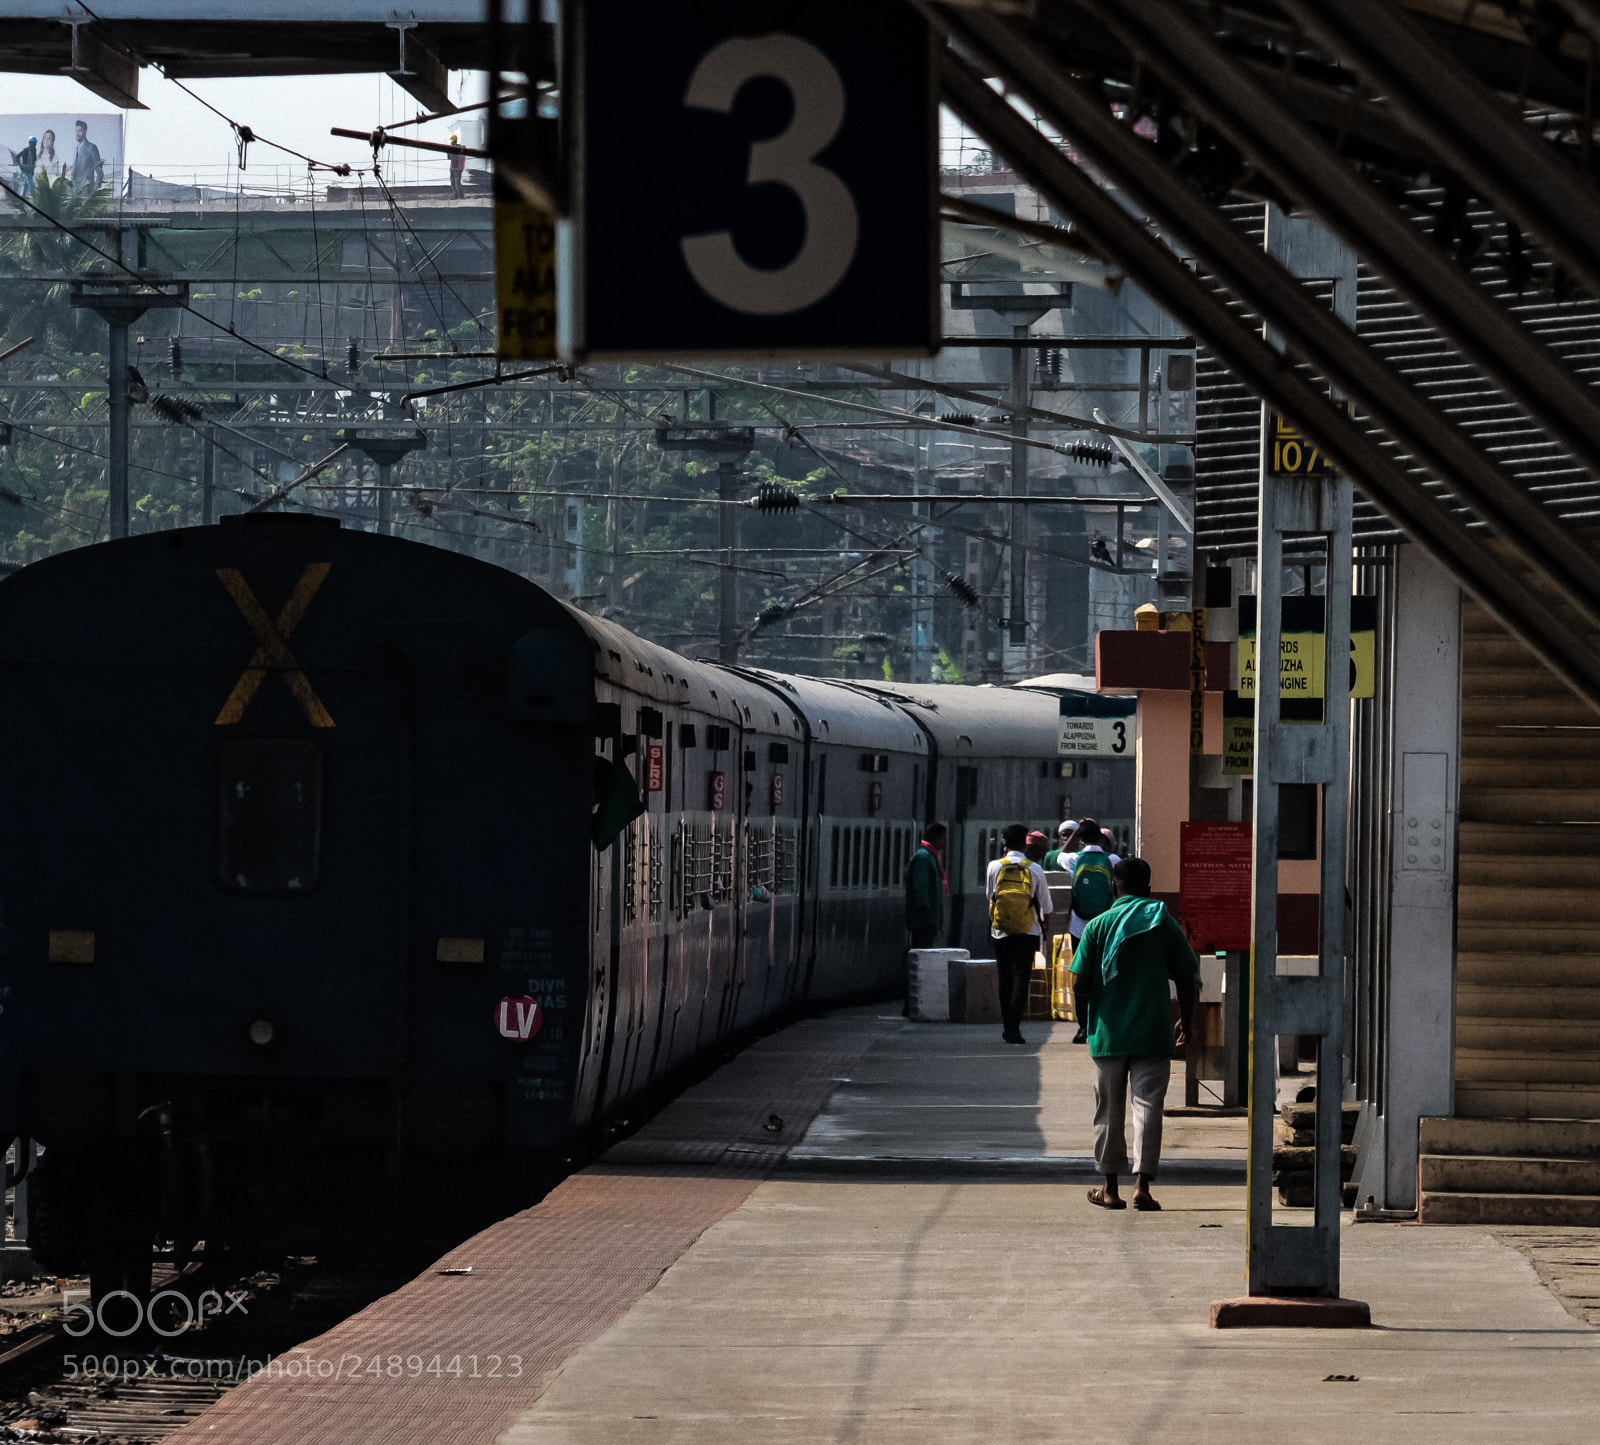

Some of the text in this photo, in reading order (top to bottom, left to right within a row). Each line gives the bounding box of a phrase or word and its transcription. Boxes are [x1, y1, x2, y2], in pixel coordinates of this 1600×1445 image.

[680, 33, 858, 314] 3
[1274, 441, 1332, 472] 107
[1250, 641, 1299, 654] TRDS
[1280, 677, 1308, 689] NGINE
[1063, 732, 1096, 740] ALAPPUZHA
[1066, 721, 1094, 730] TOWARDS
[1111, 721, 1127, 753] 3
[1060, 742, 1099, 751] FROM ENGINE
[650, 748, 661, 789] SLRD
[1225, 757, 1249, 768] FROM
[713, 775, 724, 809] GS
[774, 775, 783, 803] GS
[499, 1001, 537, 1039] LV
